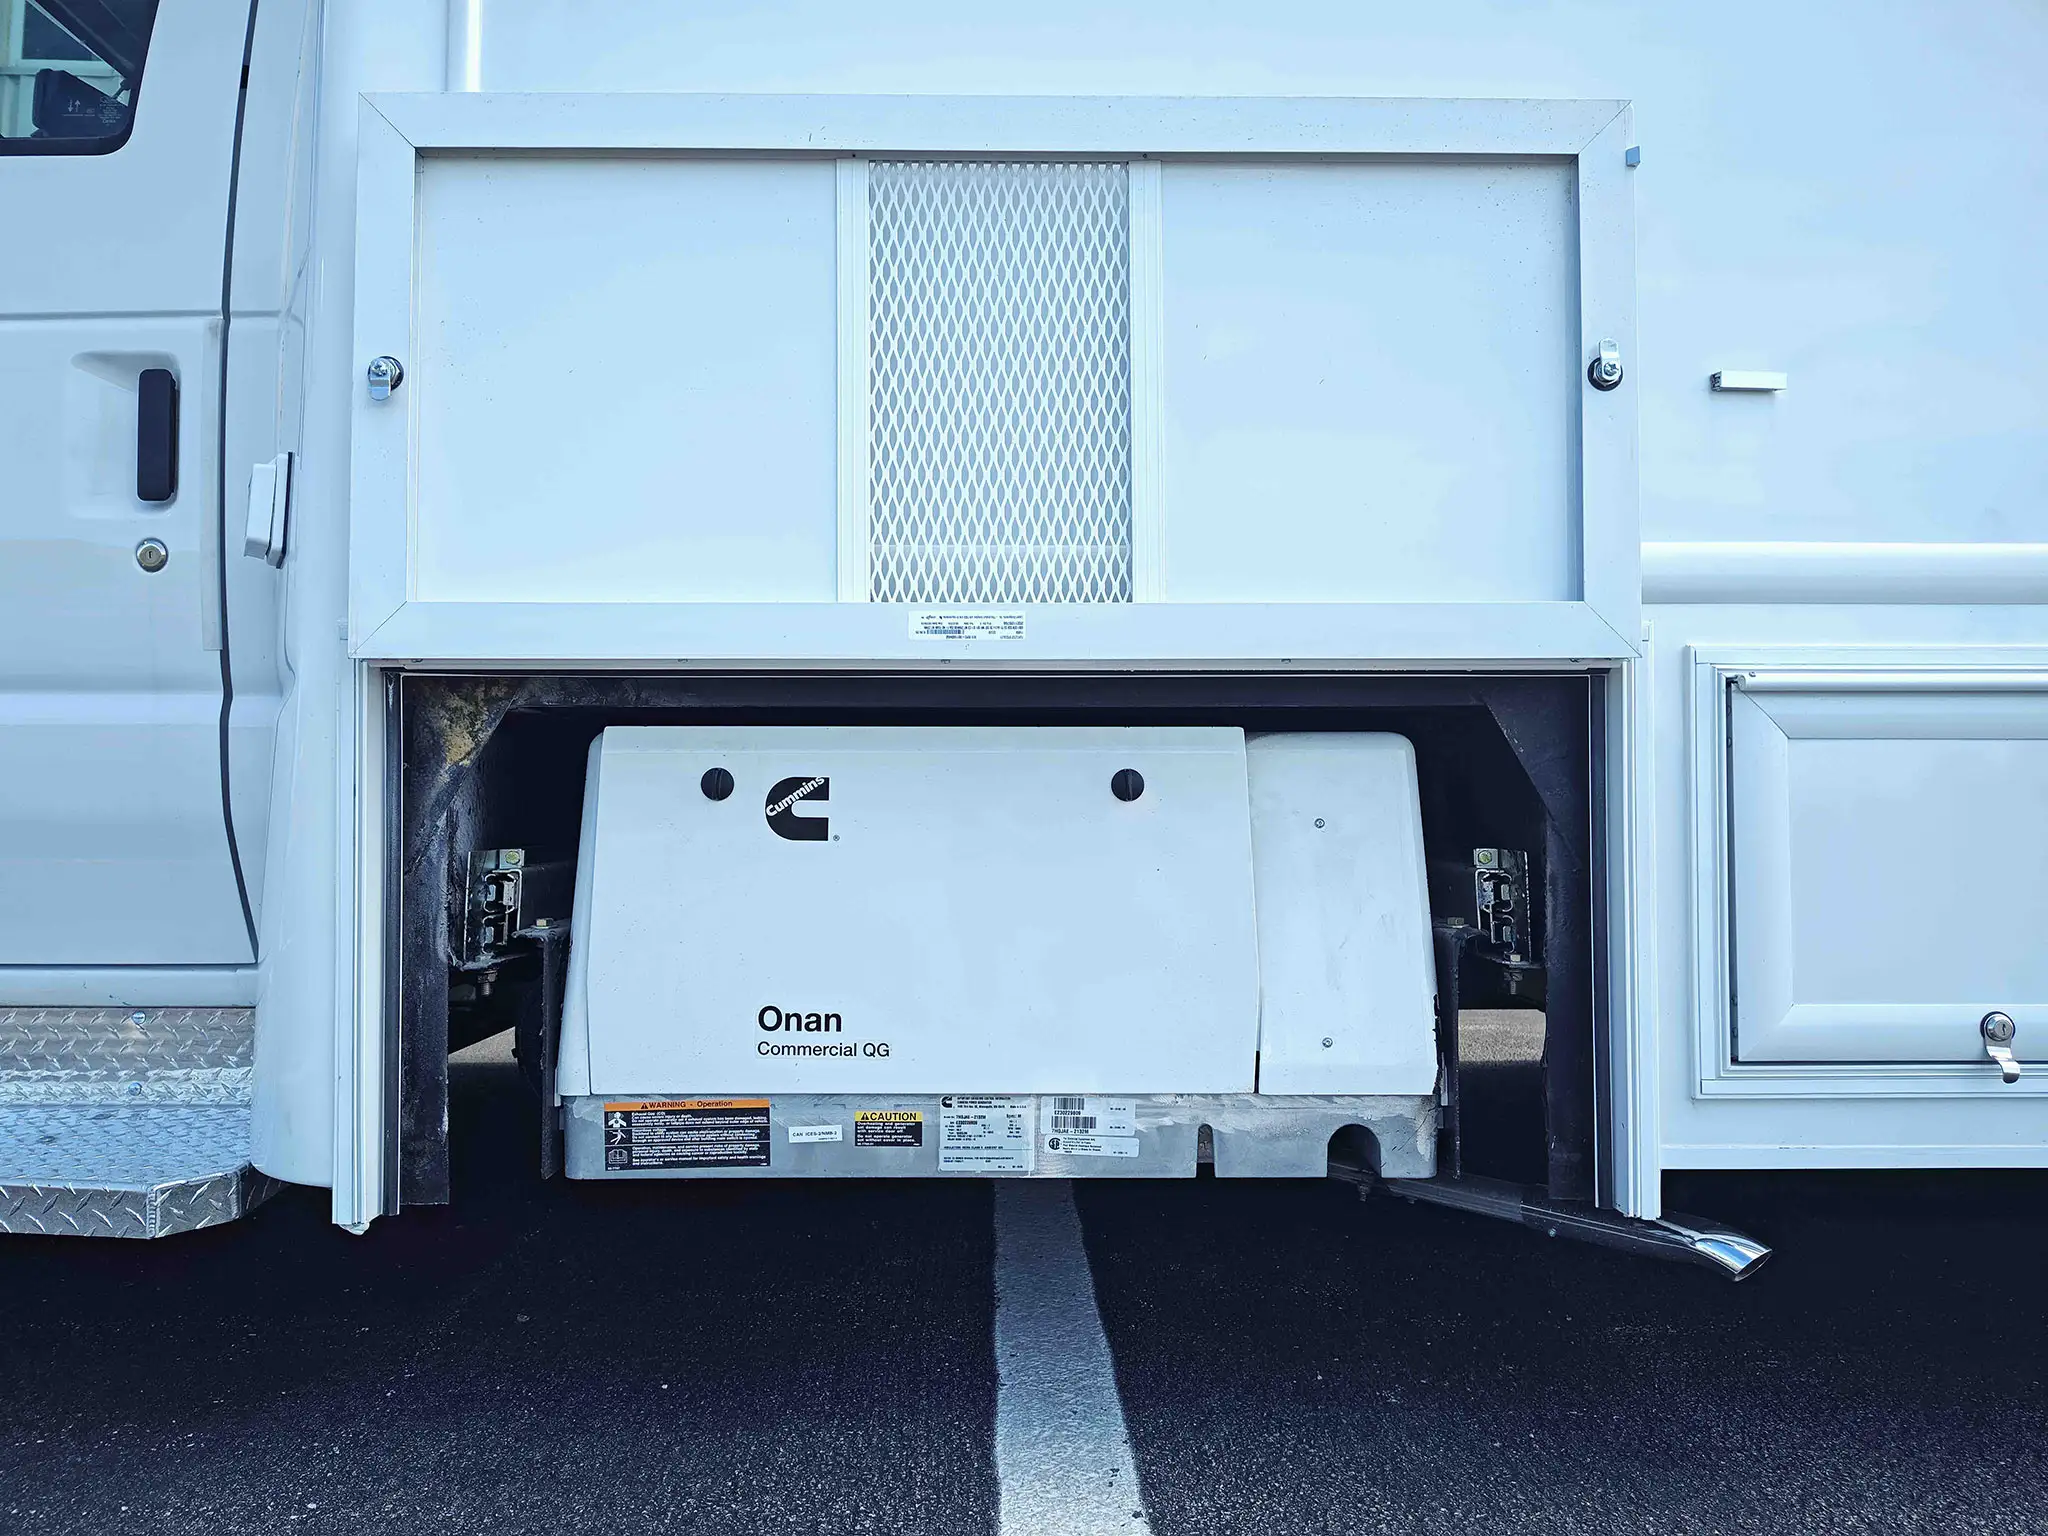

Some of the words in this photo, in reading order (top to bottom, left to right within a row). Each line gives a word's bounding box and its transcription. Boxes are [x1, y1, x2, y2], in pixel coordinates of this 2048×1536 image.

[765, 776, 825, 817] Cummins
[758, 1005, 842, 1032] Onan
[757, 1041, 857, 1056] Commercial
[863, 1042, 890, 1057] QG
[870, 1112, 916, 1120] CAUTION
